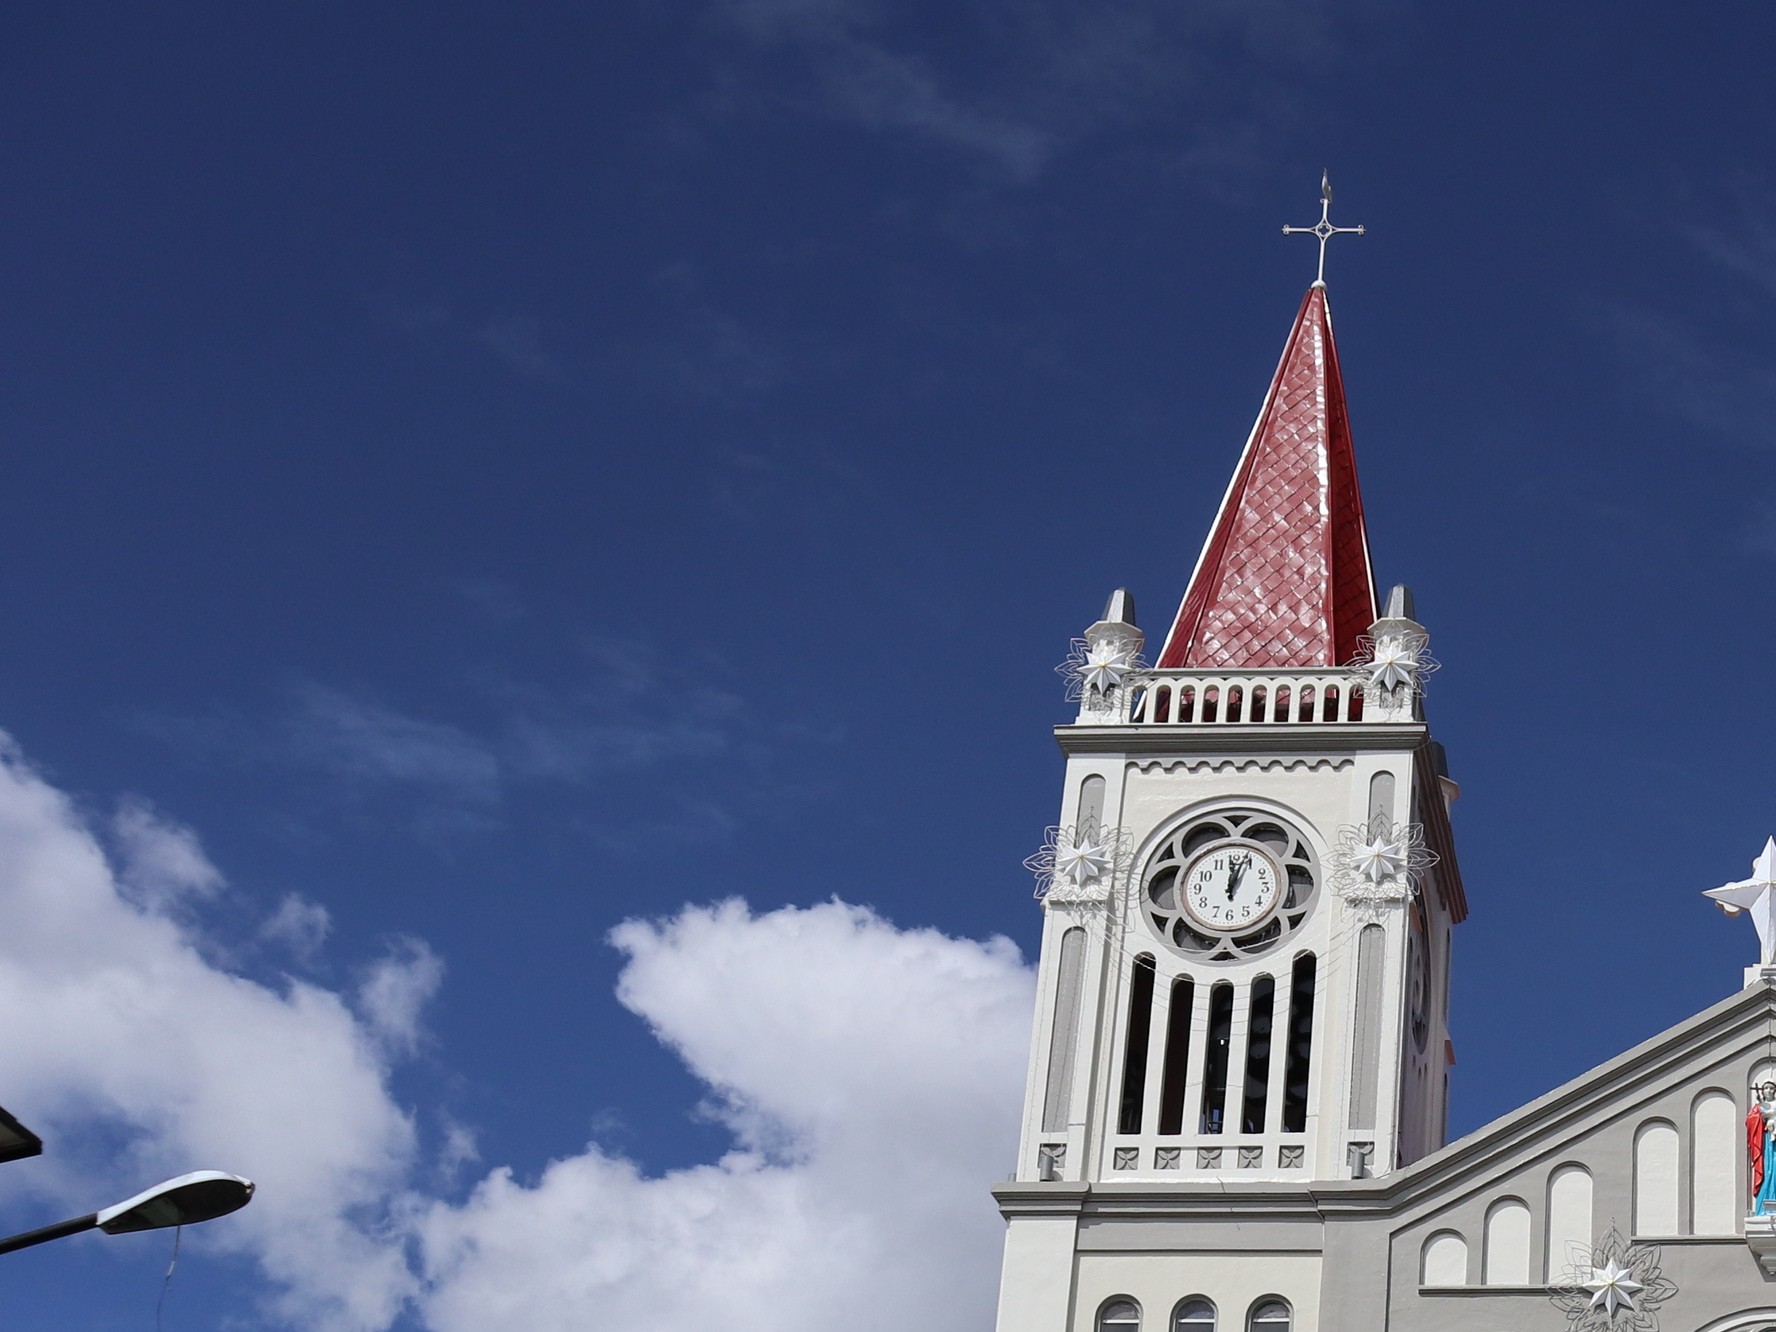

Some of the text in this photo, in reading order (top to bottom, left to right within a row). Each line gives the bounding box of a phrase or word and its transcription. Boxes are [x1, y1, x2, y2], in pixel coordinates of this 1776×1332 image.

[1214, 859, 1224, 871] 11
[1199, 871, 1212, 882] 10
[1258, 868, 1266, 880] 2
[1193, 883, 1202, 895] 9
[1261, 882, 1270, 894] 3
[1199, 896, 1208, 908] 8
[1254, 895, 1263, 907] 4
[1212, 905, 1221, 918] 7
[1225, 909, 1234, 921] 6
[1241, 905, 1250, 918] 5
